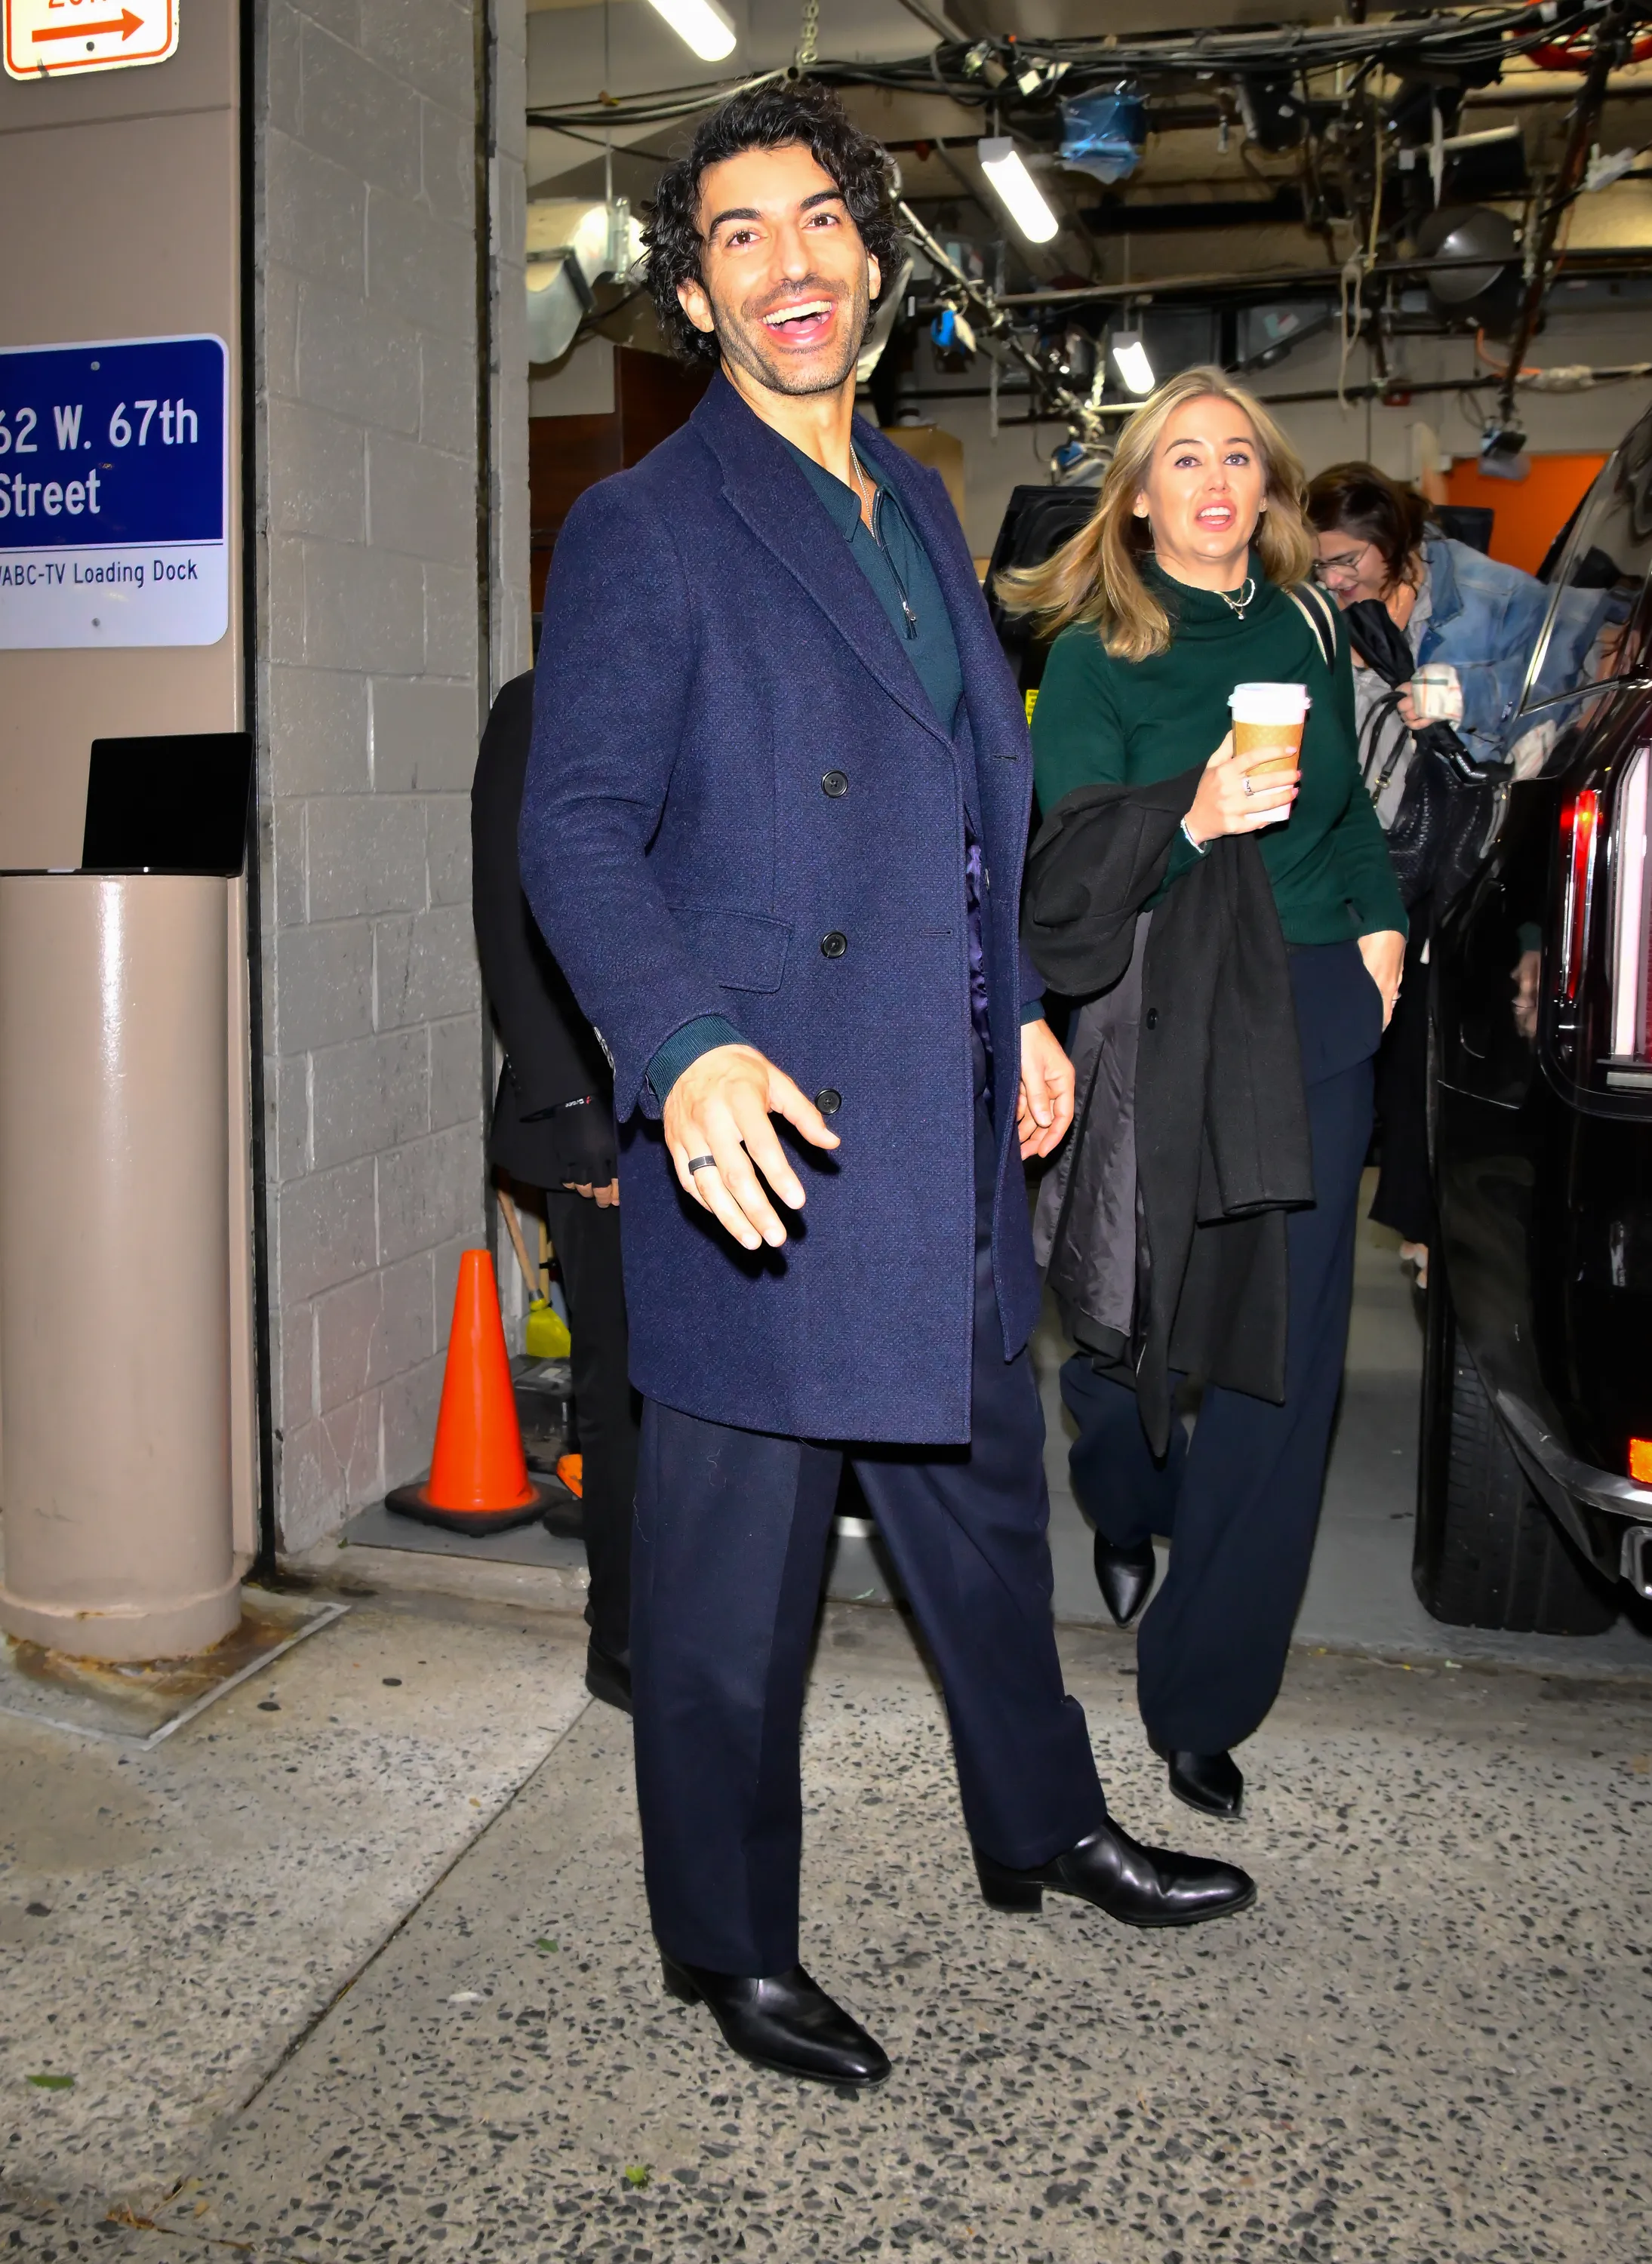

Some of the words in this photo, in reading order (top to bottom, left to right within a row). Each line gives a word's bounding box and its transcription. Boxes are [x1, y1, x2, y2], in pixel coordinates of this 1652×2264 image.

[54, 404, 91, 451] W.
[109, 398, 198, 448] 67th
[0, 468, 101, 518] Street
[0, 563, 66, 586] ABC-TV
[74, 561, 144, 589] Loading
[153, 559, 198, 580] Dock
